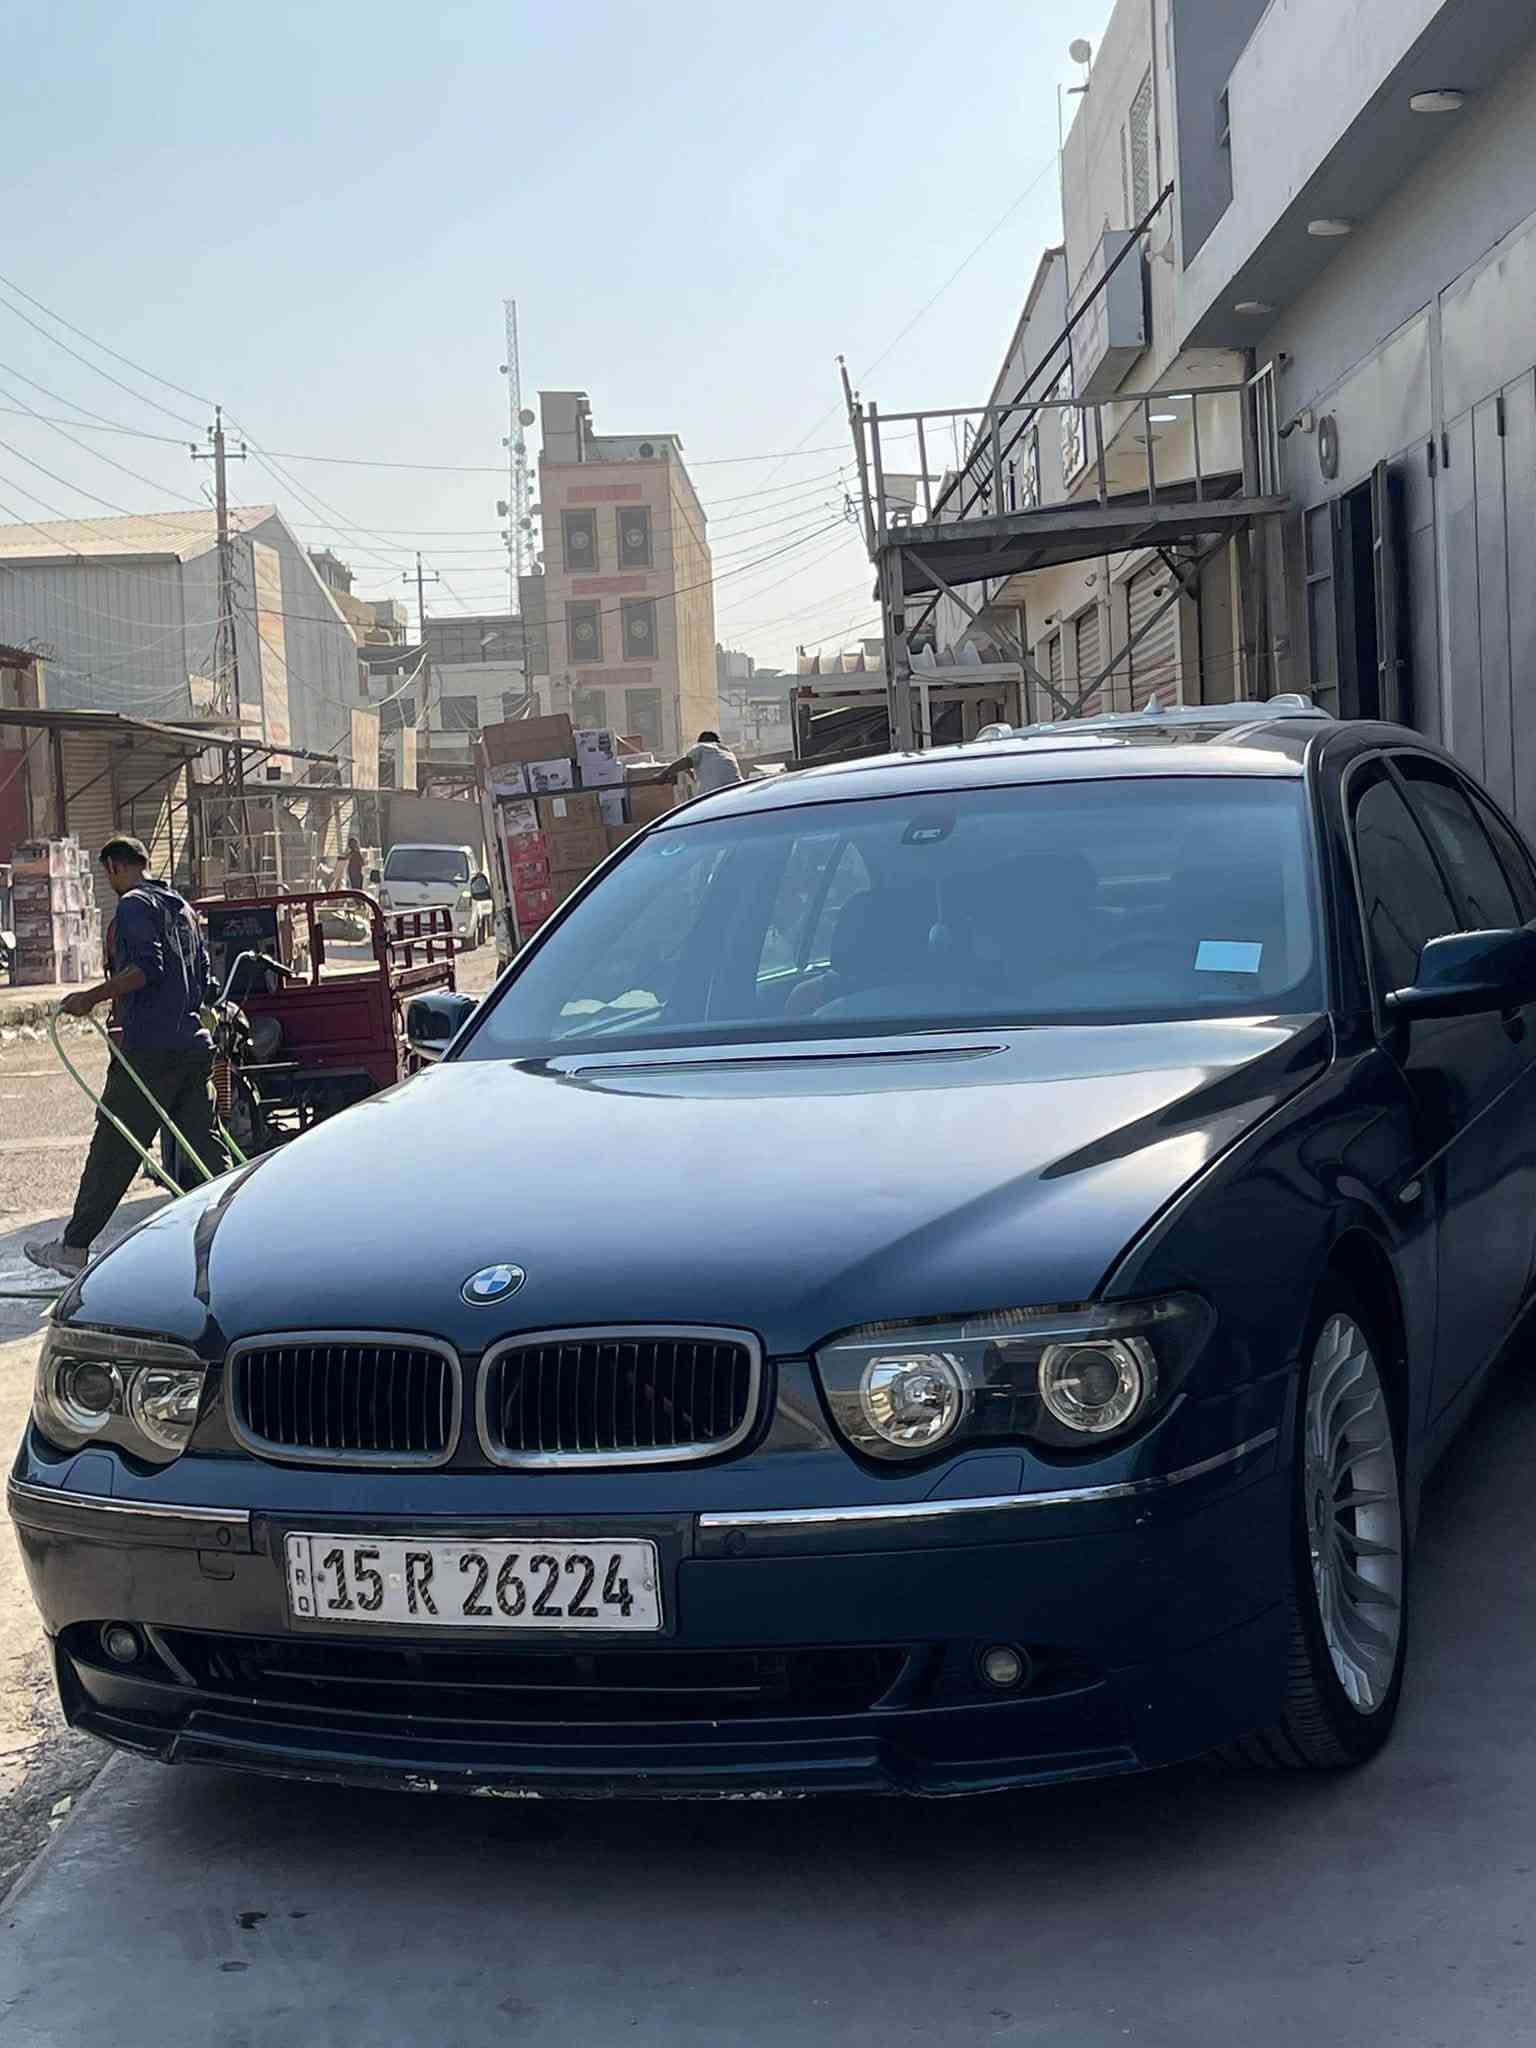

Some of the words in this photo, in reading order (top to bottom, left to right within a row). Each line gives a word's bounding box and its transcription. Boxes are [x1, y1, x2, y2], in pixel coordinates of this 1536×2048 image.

[296, 1541, 310, 1612] IRQ
[323, 1549, 384, 1611] 15
[405, 1552, 439, 1615] R
[459, 1554, 634, 1617] 26224
